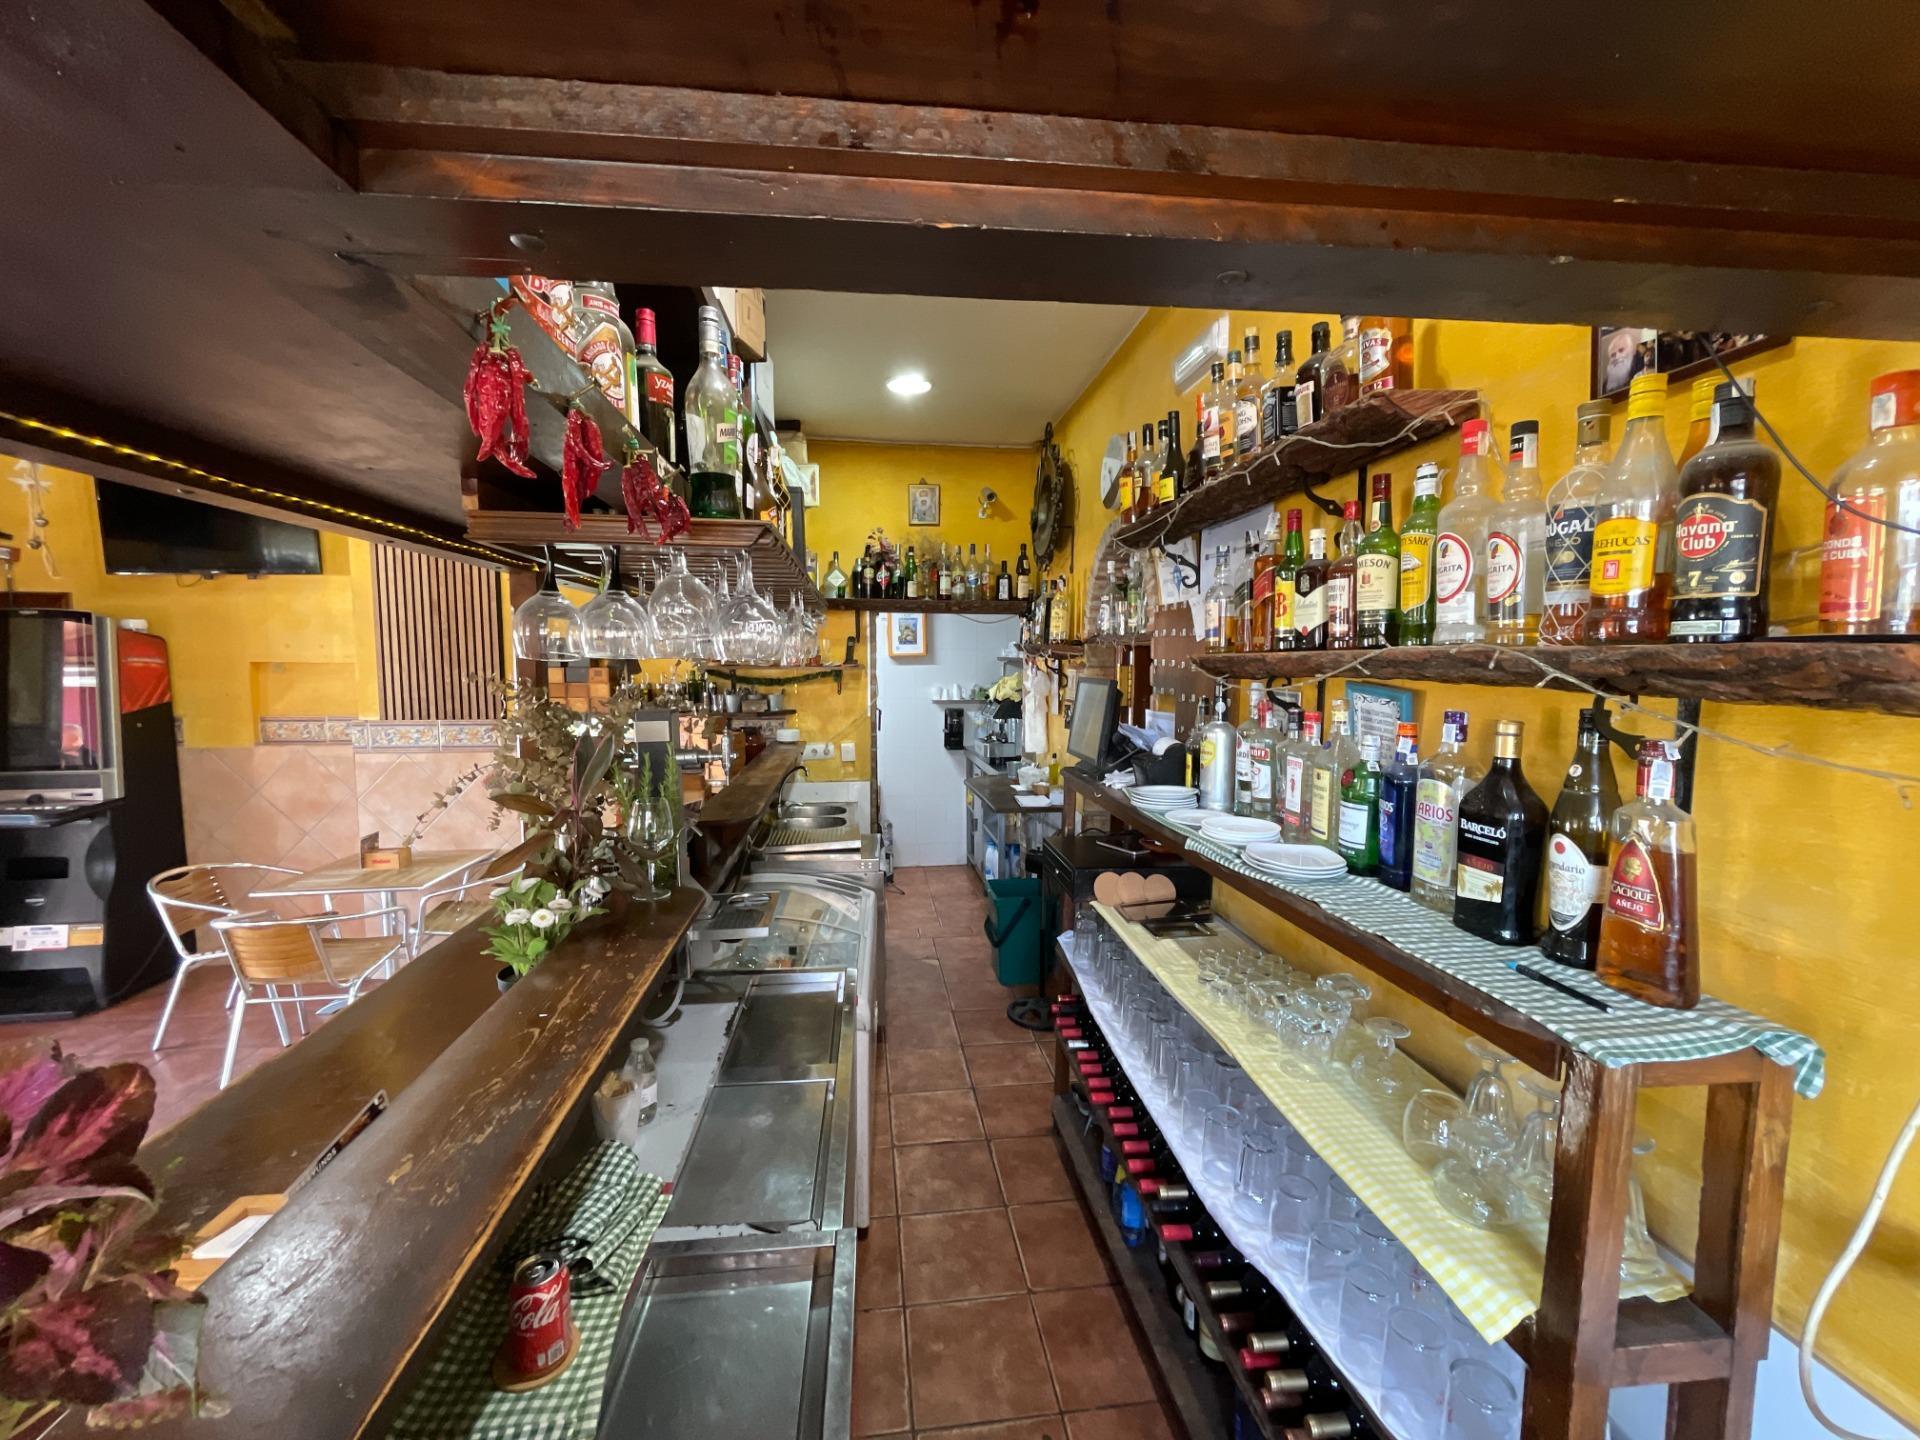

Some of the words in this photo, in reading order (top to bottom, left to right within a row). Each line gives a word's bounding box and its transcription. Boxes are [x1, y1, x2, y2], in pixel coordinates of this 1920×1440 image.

[1373, 381, 1383, 389] 12
[1676, 520, 1738, 538] Havana
[1681, 535, 1716, 551] Club
[1688, 571, 1702, 587] 7
[1460, 818, 1507, 839] BARCELÓ
[1611, 885, 1655, 904] CACIQUE
[1616, 899, 1643, 913] AÑEJO
